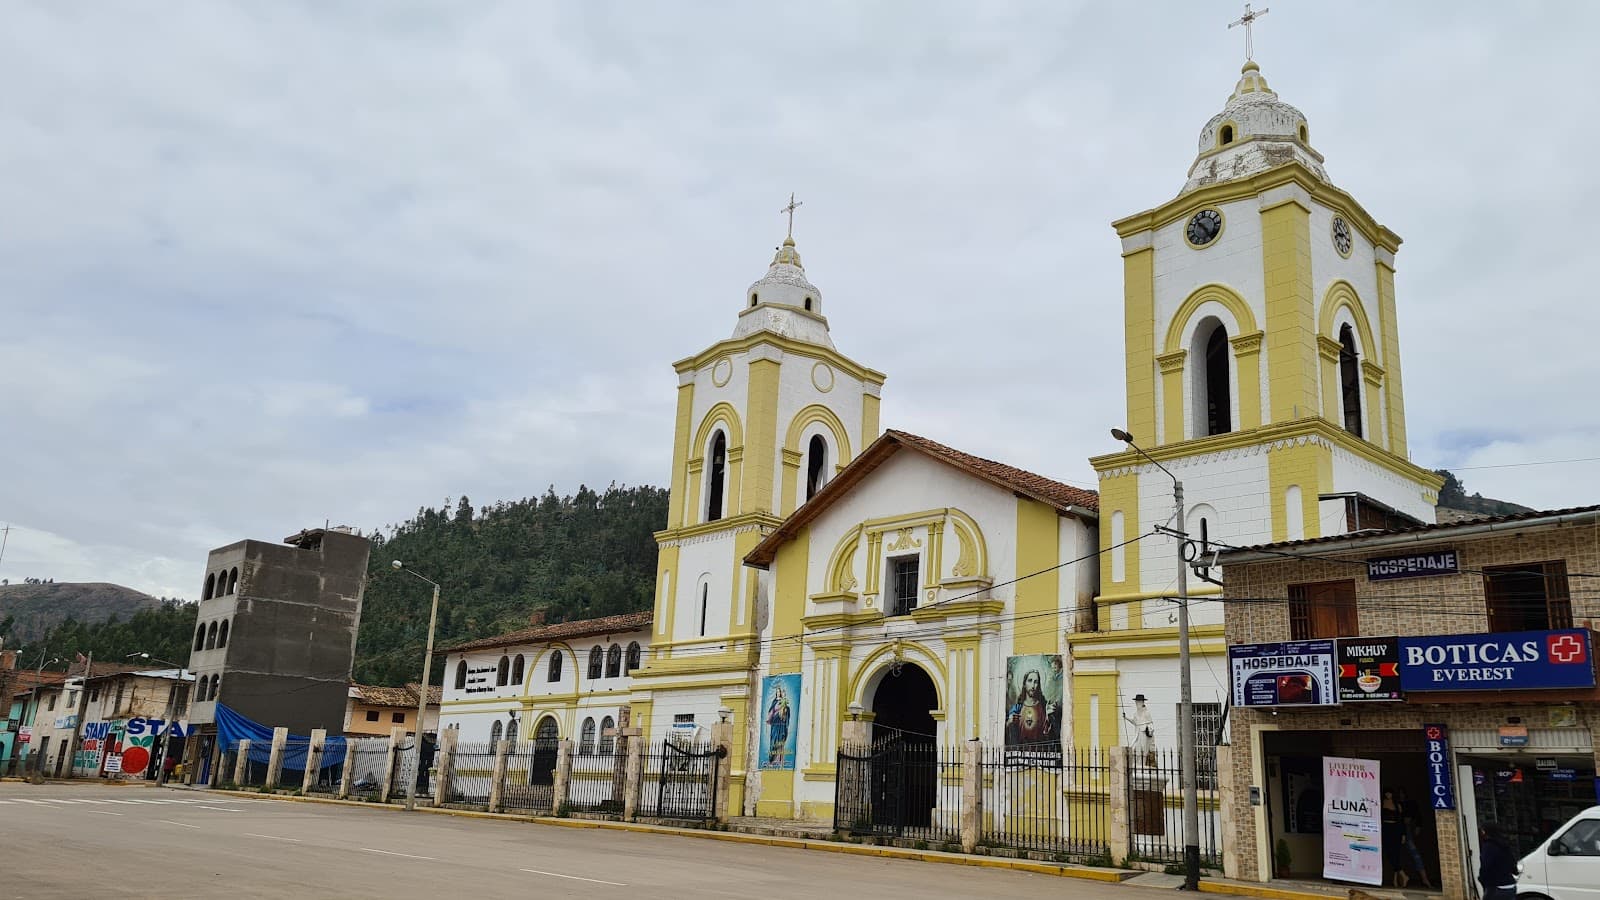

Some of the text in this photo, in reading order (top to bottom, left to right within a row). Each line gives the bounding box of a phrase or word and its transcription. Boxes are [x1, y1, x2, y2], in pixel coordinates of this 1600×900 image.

[1368, 554, 1456, 576] HOSPEDAJE
[1346, 644, 1388, 657] MIKHUY
[1406, 641, 1540, 666] BOTICAS
[1242, 655, 1320, 670] HOSPEDAJE
[1432, 667, 1514, 683] EVEREST
[1329, 769, 1376, 780] FASHION
[1349, 763, 1366, 772] FOR
[1429, 740, 1449, 808] BOTICA
[1332, 799, 1368, 813] LUNA
